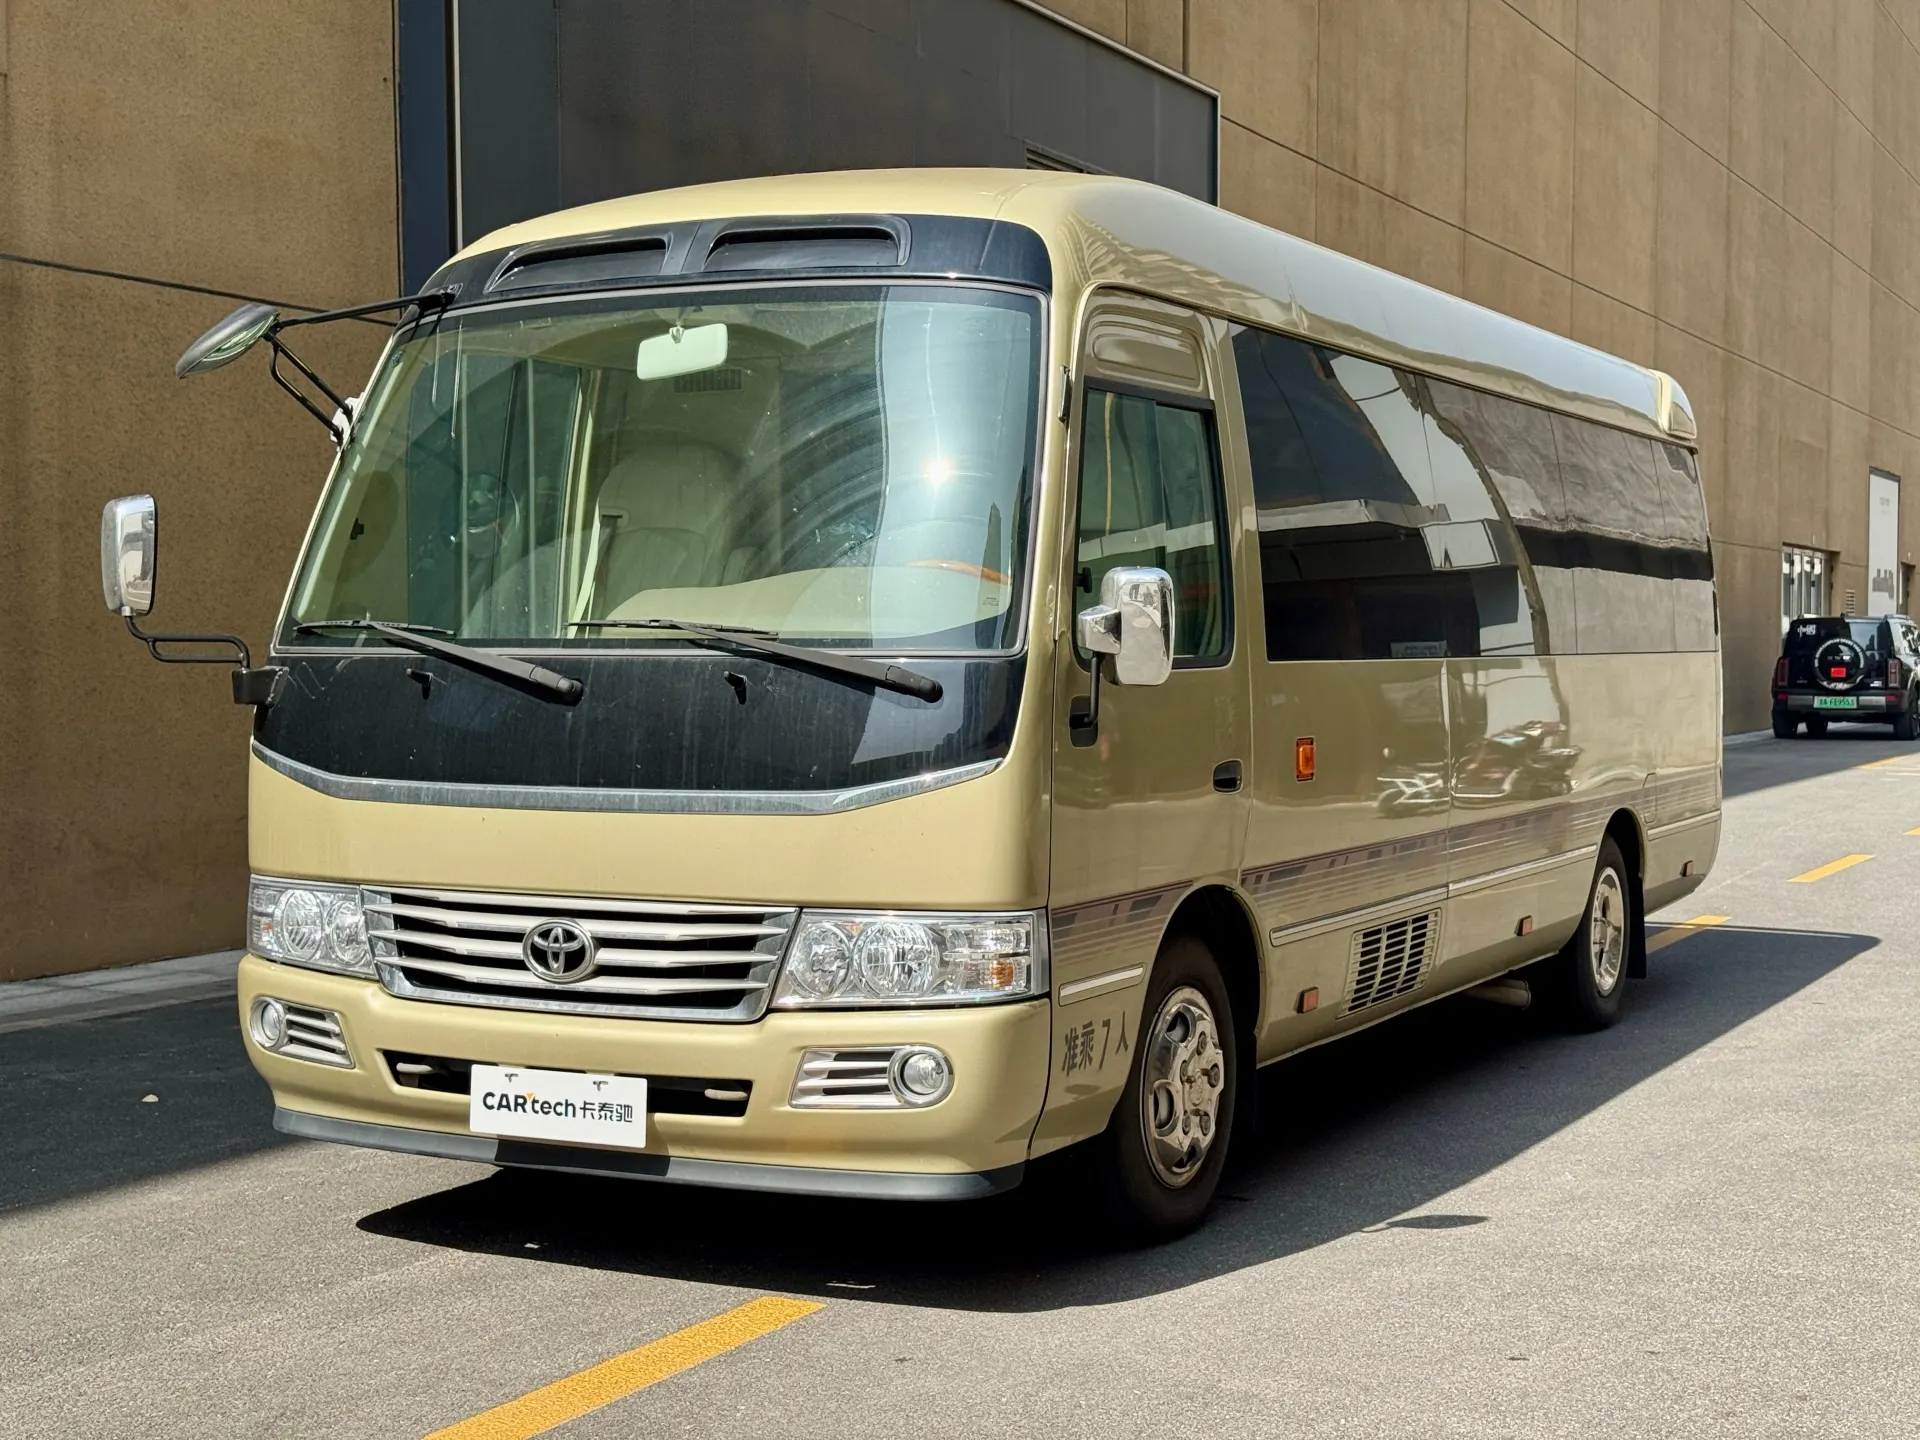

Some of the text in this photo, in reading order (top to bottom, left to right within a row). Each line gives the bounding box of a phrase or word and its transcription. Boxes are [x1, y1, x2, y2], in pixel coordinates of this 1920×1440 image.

[482, 1091, 633, 1123] CARtech 卡泰驰
